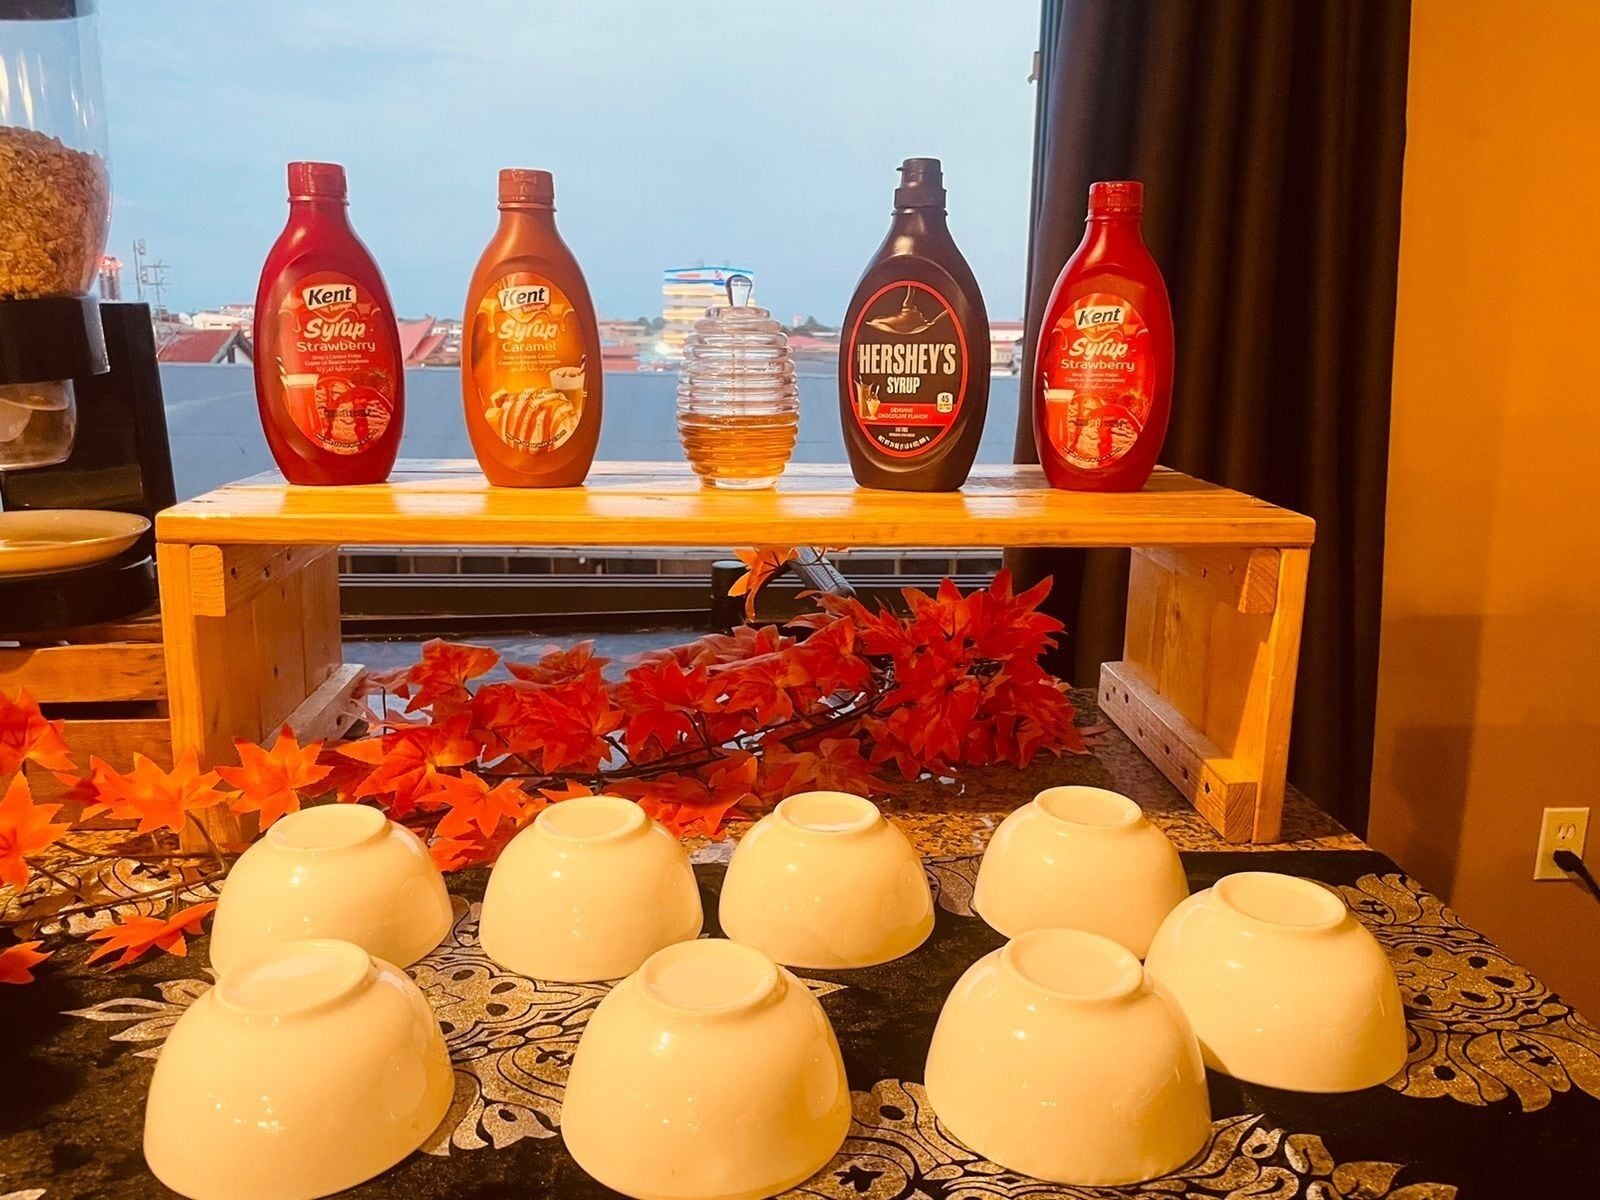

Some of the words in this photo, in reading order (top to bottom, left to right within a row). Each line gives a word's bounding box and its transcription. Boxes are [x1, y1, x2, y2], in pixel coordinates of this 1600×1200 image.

[308, 286, 353, 306] Kent
[502, 287, 545, 307] Kent
[1078, 308, 1121, 326] Kent
[303, 317, 366, 342] Syrup
[497, 319, 559, 343] Syrup
[296, 341, 376, 352] Strawberry
[502, 341, 556, 352] Caramel
[1068, 337, 1129, 361] Syrup
[858, 343, 957, 375] HERSHEY'S
[1061, 359, 1135, 372] Strawberry
[886, 376, 921, 394] SYRUP
[940, 394, 950, 403] 45
